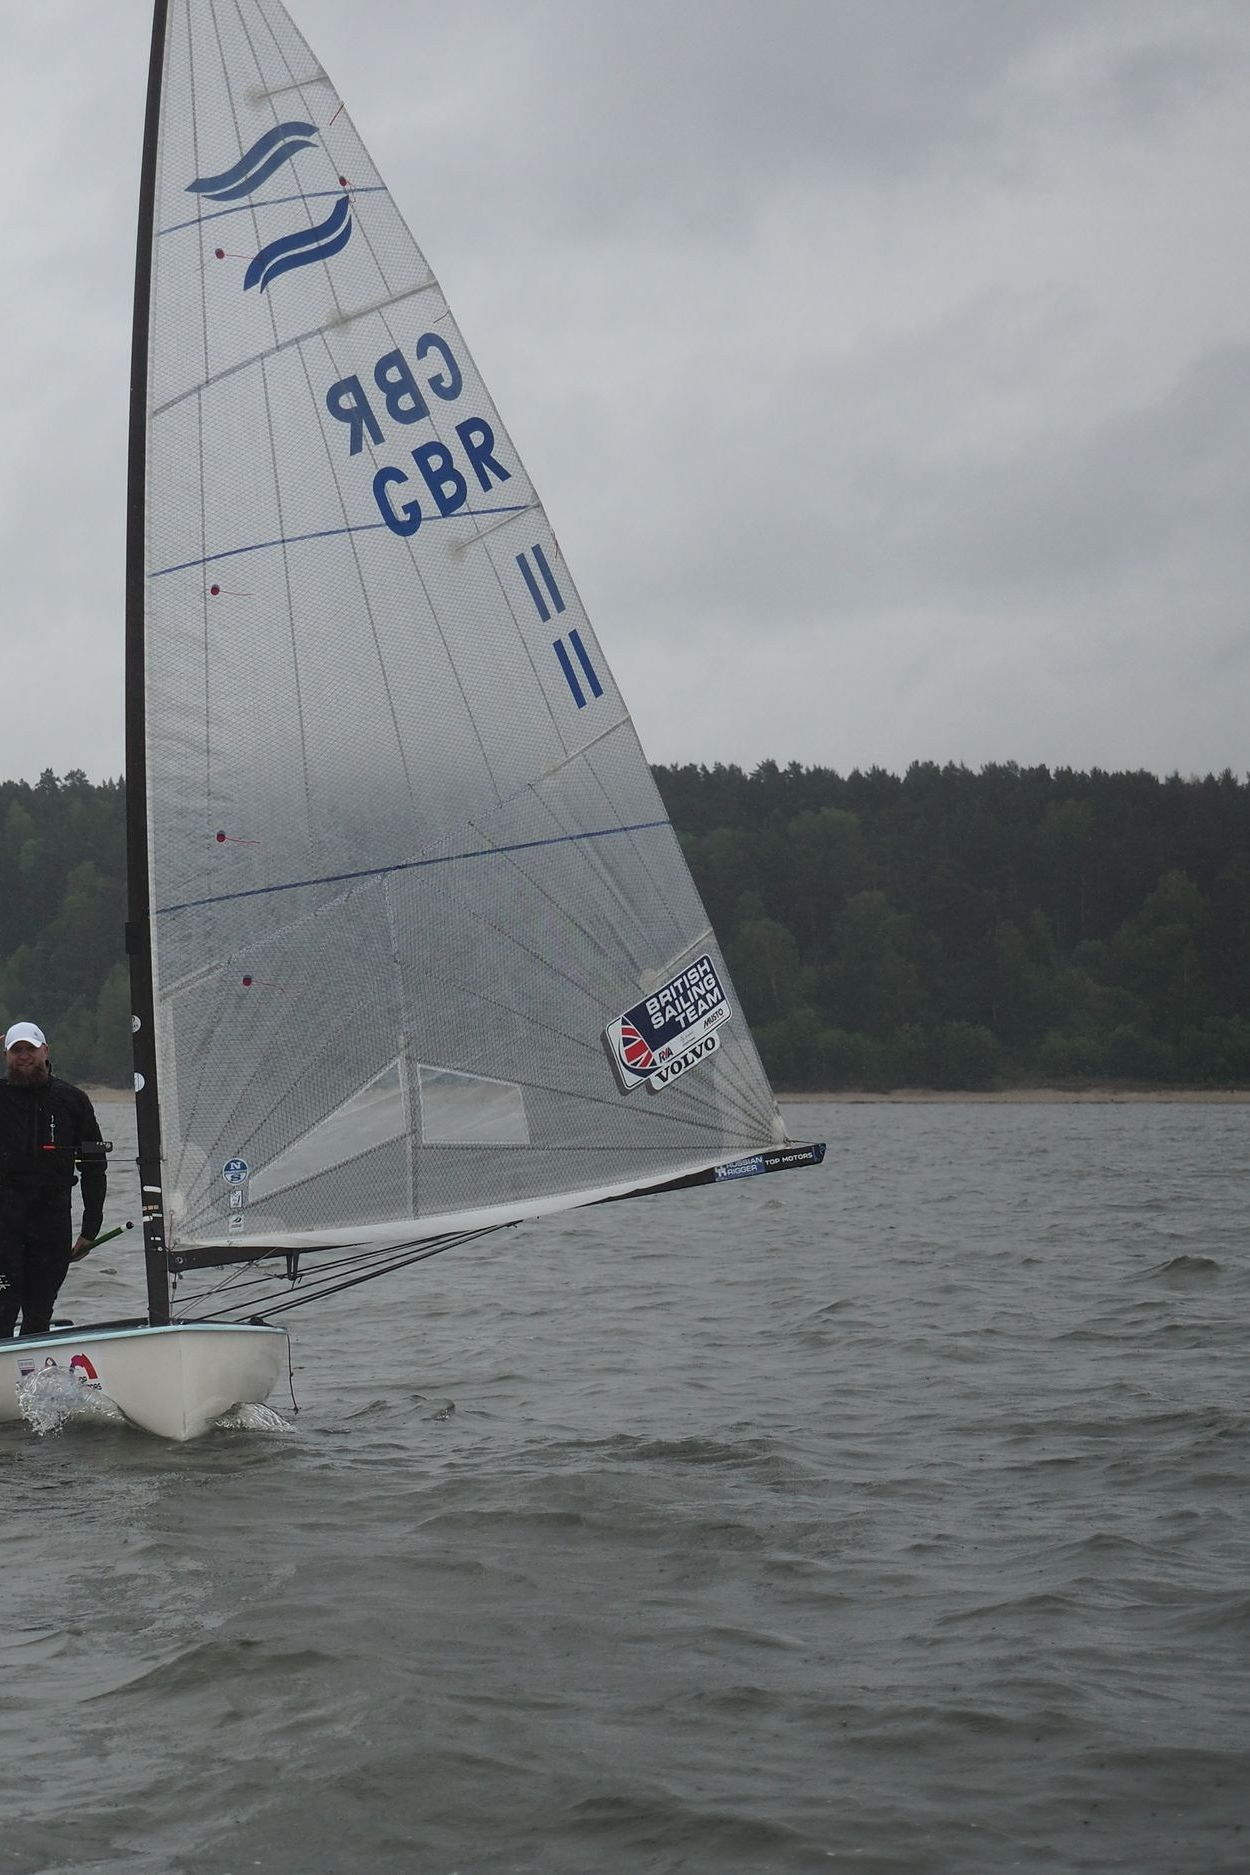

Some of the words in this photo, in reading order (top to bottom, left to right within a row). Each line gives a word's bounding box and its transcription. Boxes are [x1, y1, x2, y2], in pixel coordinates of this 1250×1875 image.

[372, 416, 512, 537] GBR
[552, 628, 604, 710] 11
[645, 958, 711, 1016] BRITISH
[651, 972, 716, 1030] SAILING
[674, 987, 722, 1029] TEAM
[703, 1008, 724, 1029] MUSTO
[654, 1036, 716, 1083] VOLVO
[658, 1046, 674, 1063] RYA
[726, 1155, 763, 1168] RUSSIAN
[727, 1164, 758, 1176] RIGGER
[764, 1157, 781, 1166] TOP
[782, 1151, 813, 1163] MOTORS
